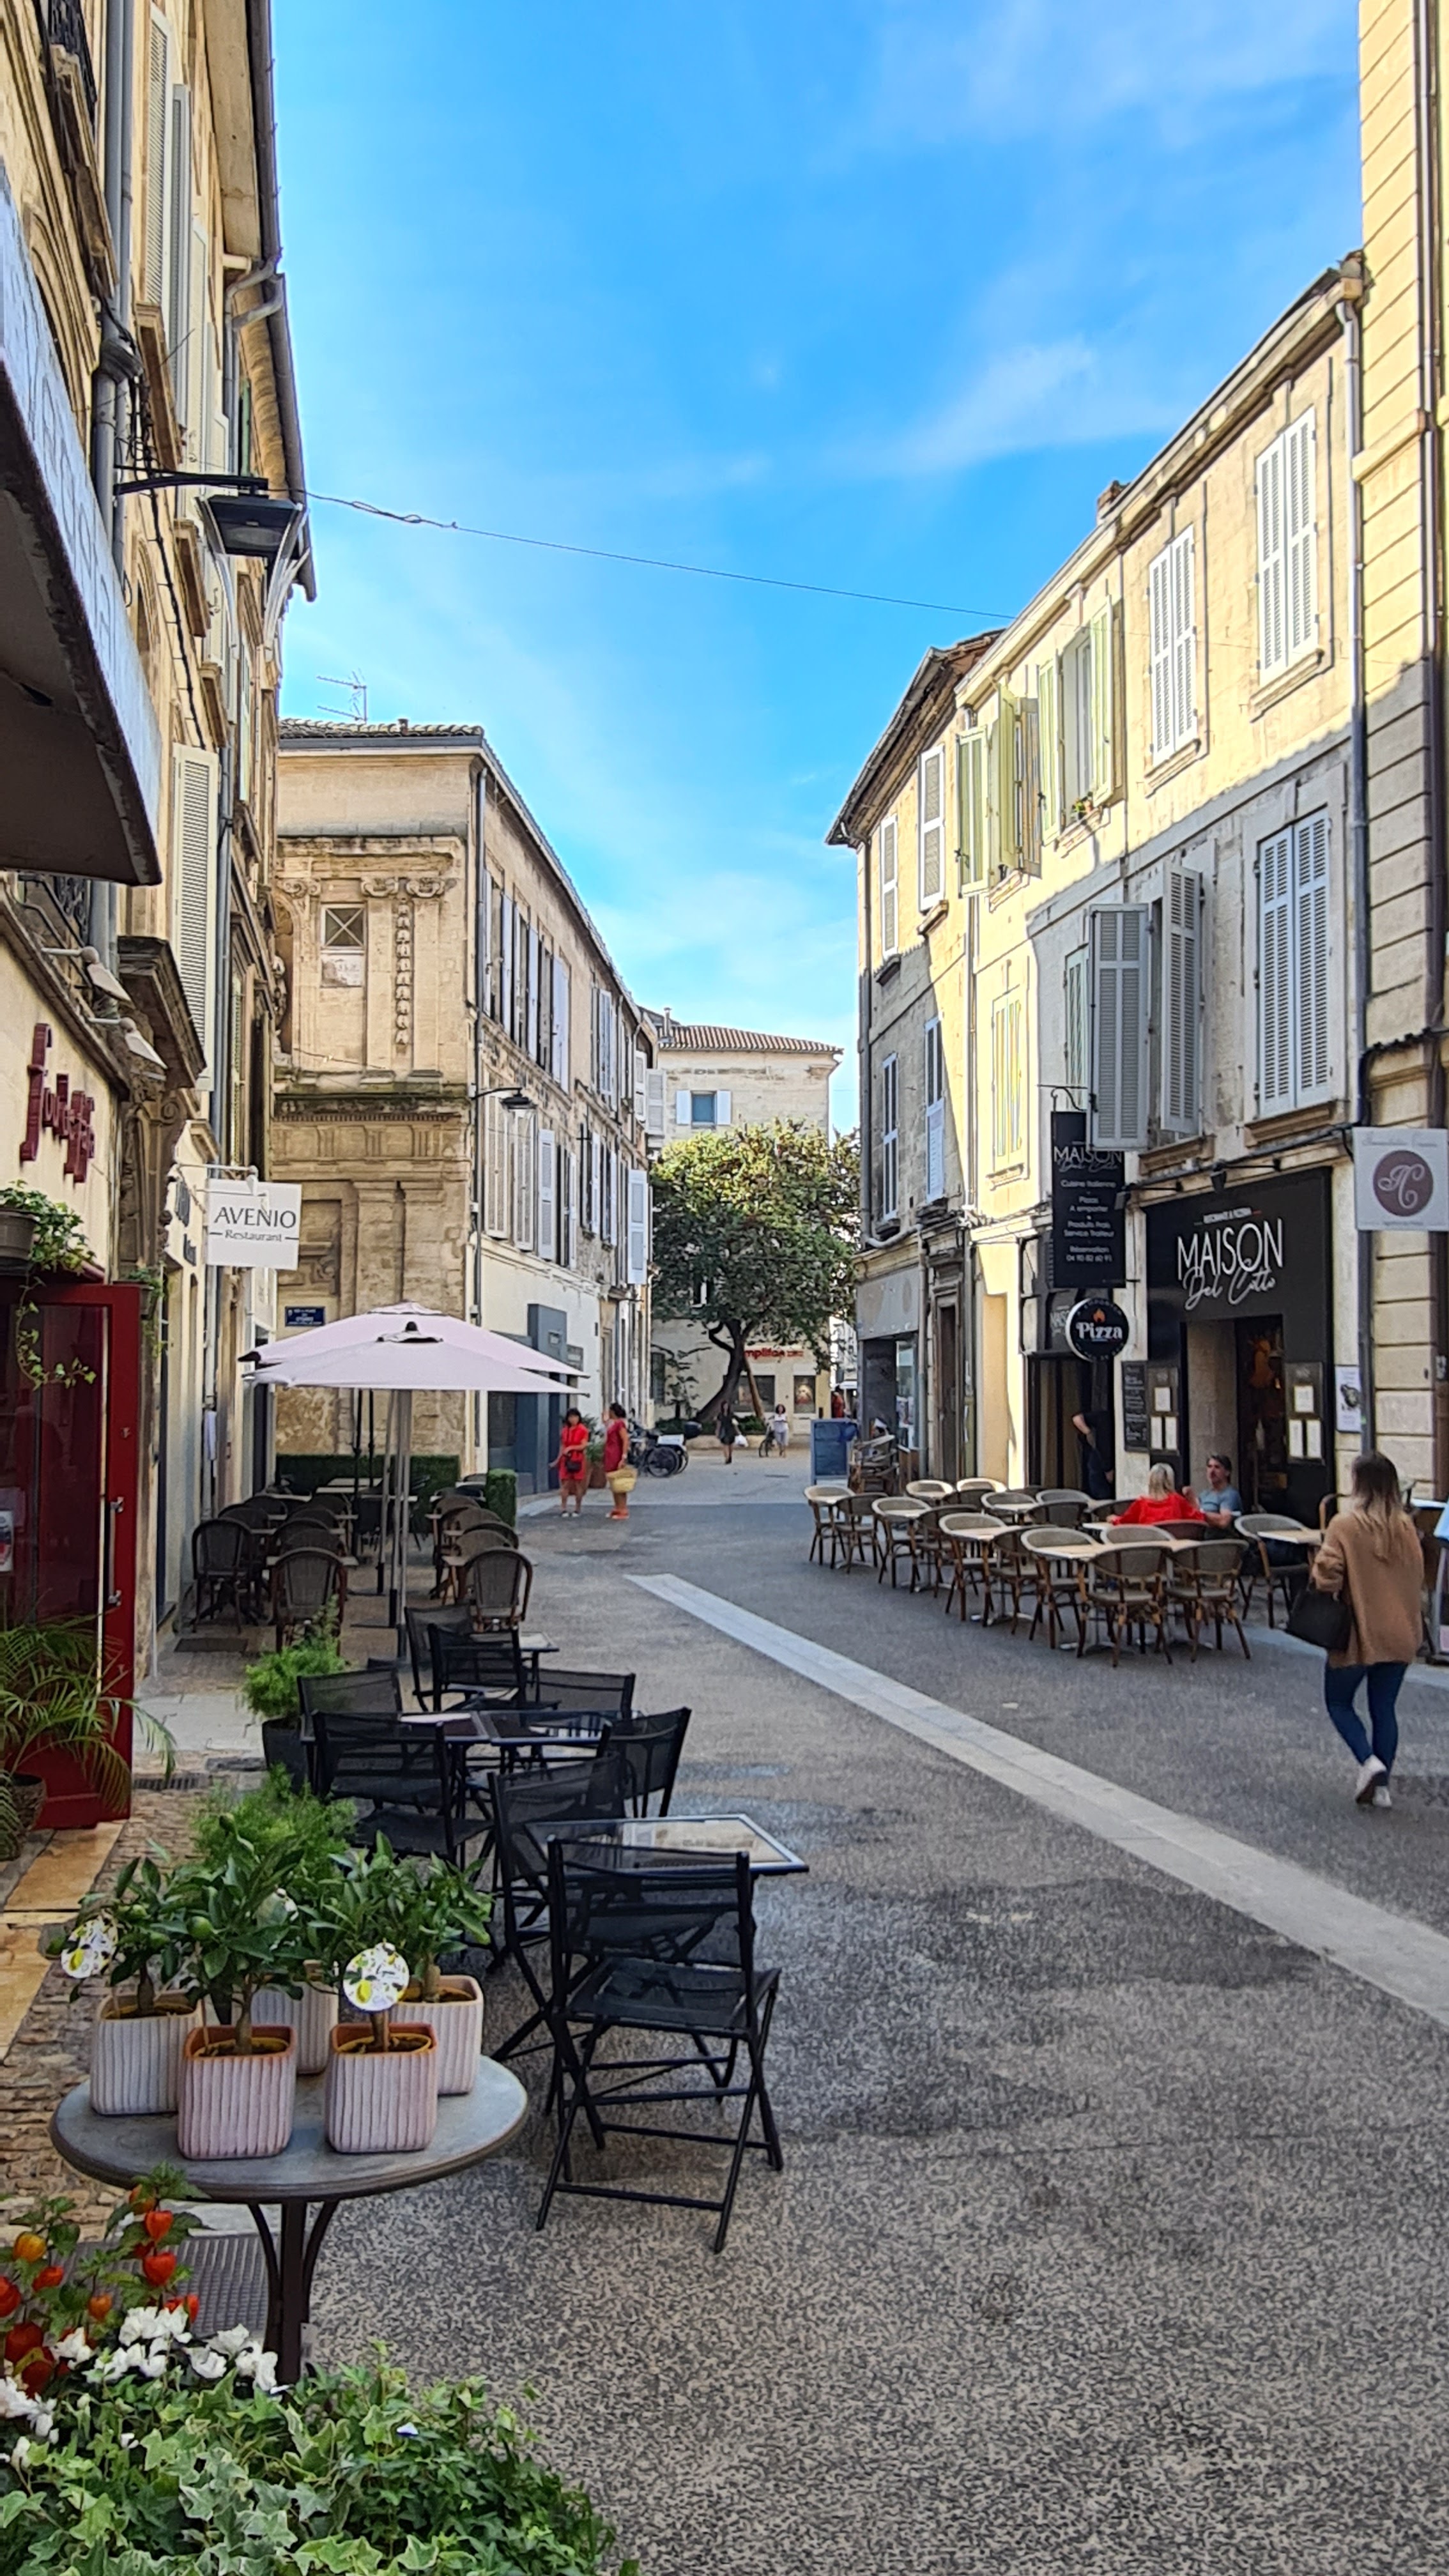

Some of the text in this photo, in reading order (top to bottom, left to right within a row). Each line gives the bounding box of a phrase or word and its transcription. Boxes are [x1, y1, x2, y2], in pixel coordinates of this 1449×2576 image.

[1054, 1146, 1123, 1163] MAISON
[214, 1206, 296, 1229] AVENIO
[225, 1229, 282, 1242] Restaurant
[1177, 1216, 1283, 1281] MAISON
[1183, 1266, 1223, 1310] Del
[1075, 1322, 1123, 1339] Pizza
